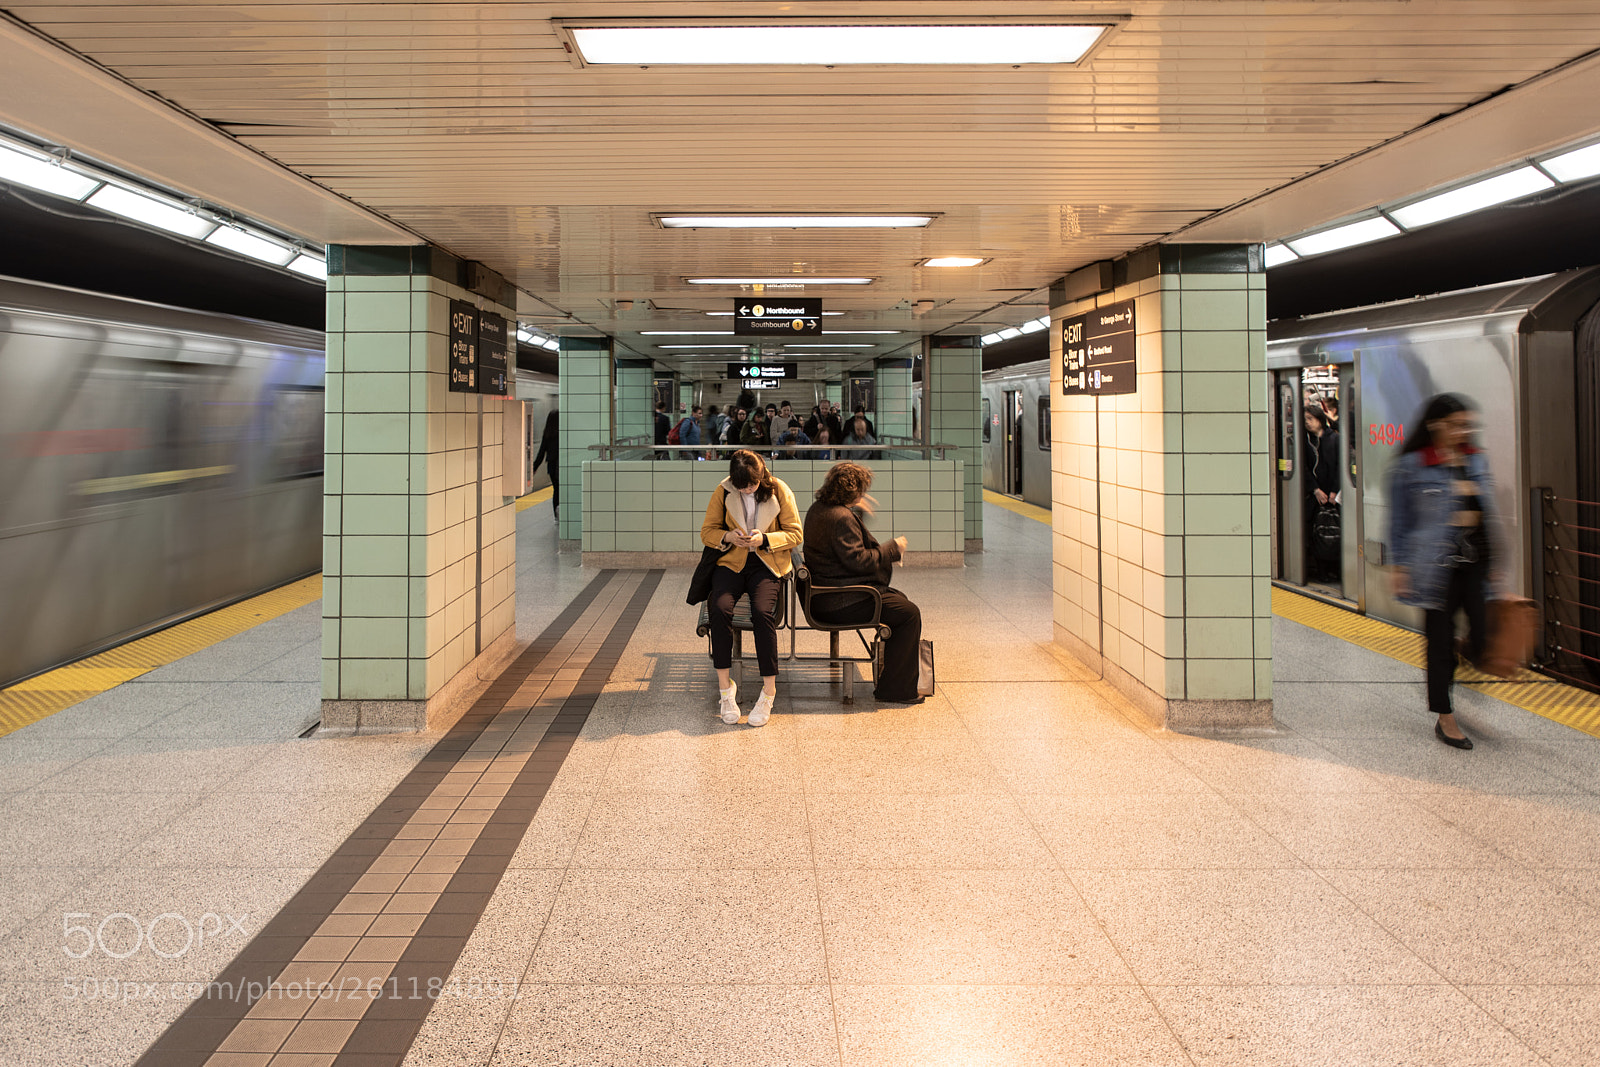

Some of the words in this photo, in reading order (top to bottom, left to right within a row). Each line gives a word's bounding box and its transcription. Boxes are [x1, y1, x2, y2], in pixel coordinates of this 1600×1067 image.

[766, 307, 805, 315] Northbound
[458, 312, 473, 336] EXIT
[1068, 322, 1083, 344] EXIT
[1369, 423, 1405, 446] 5494
